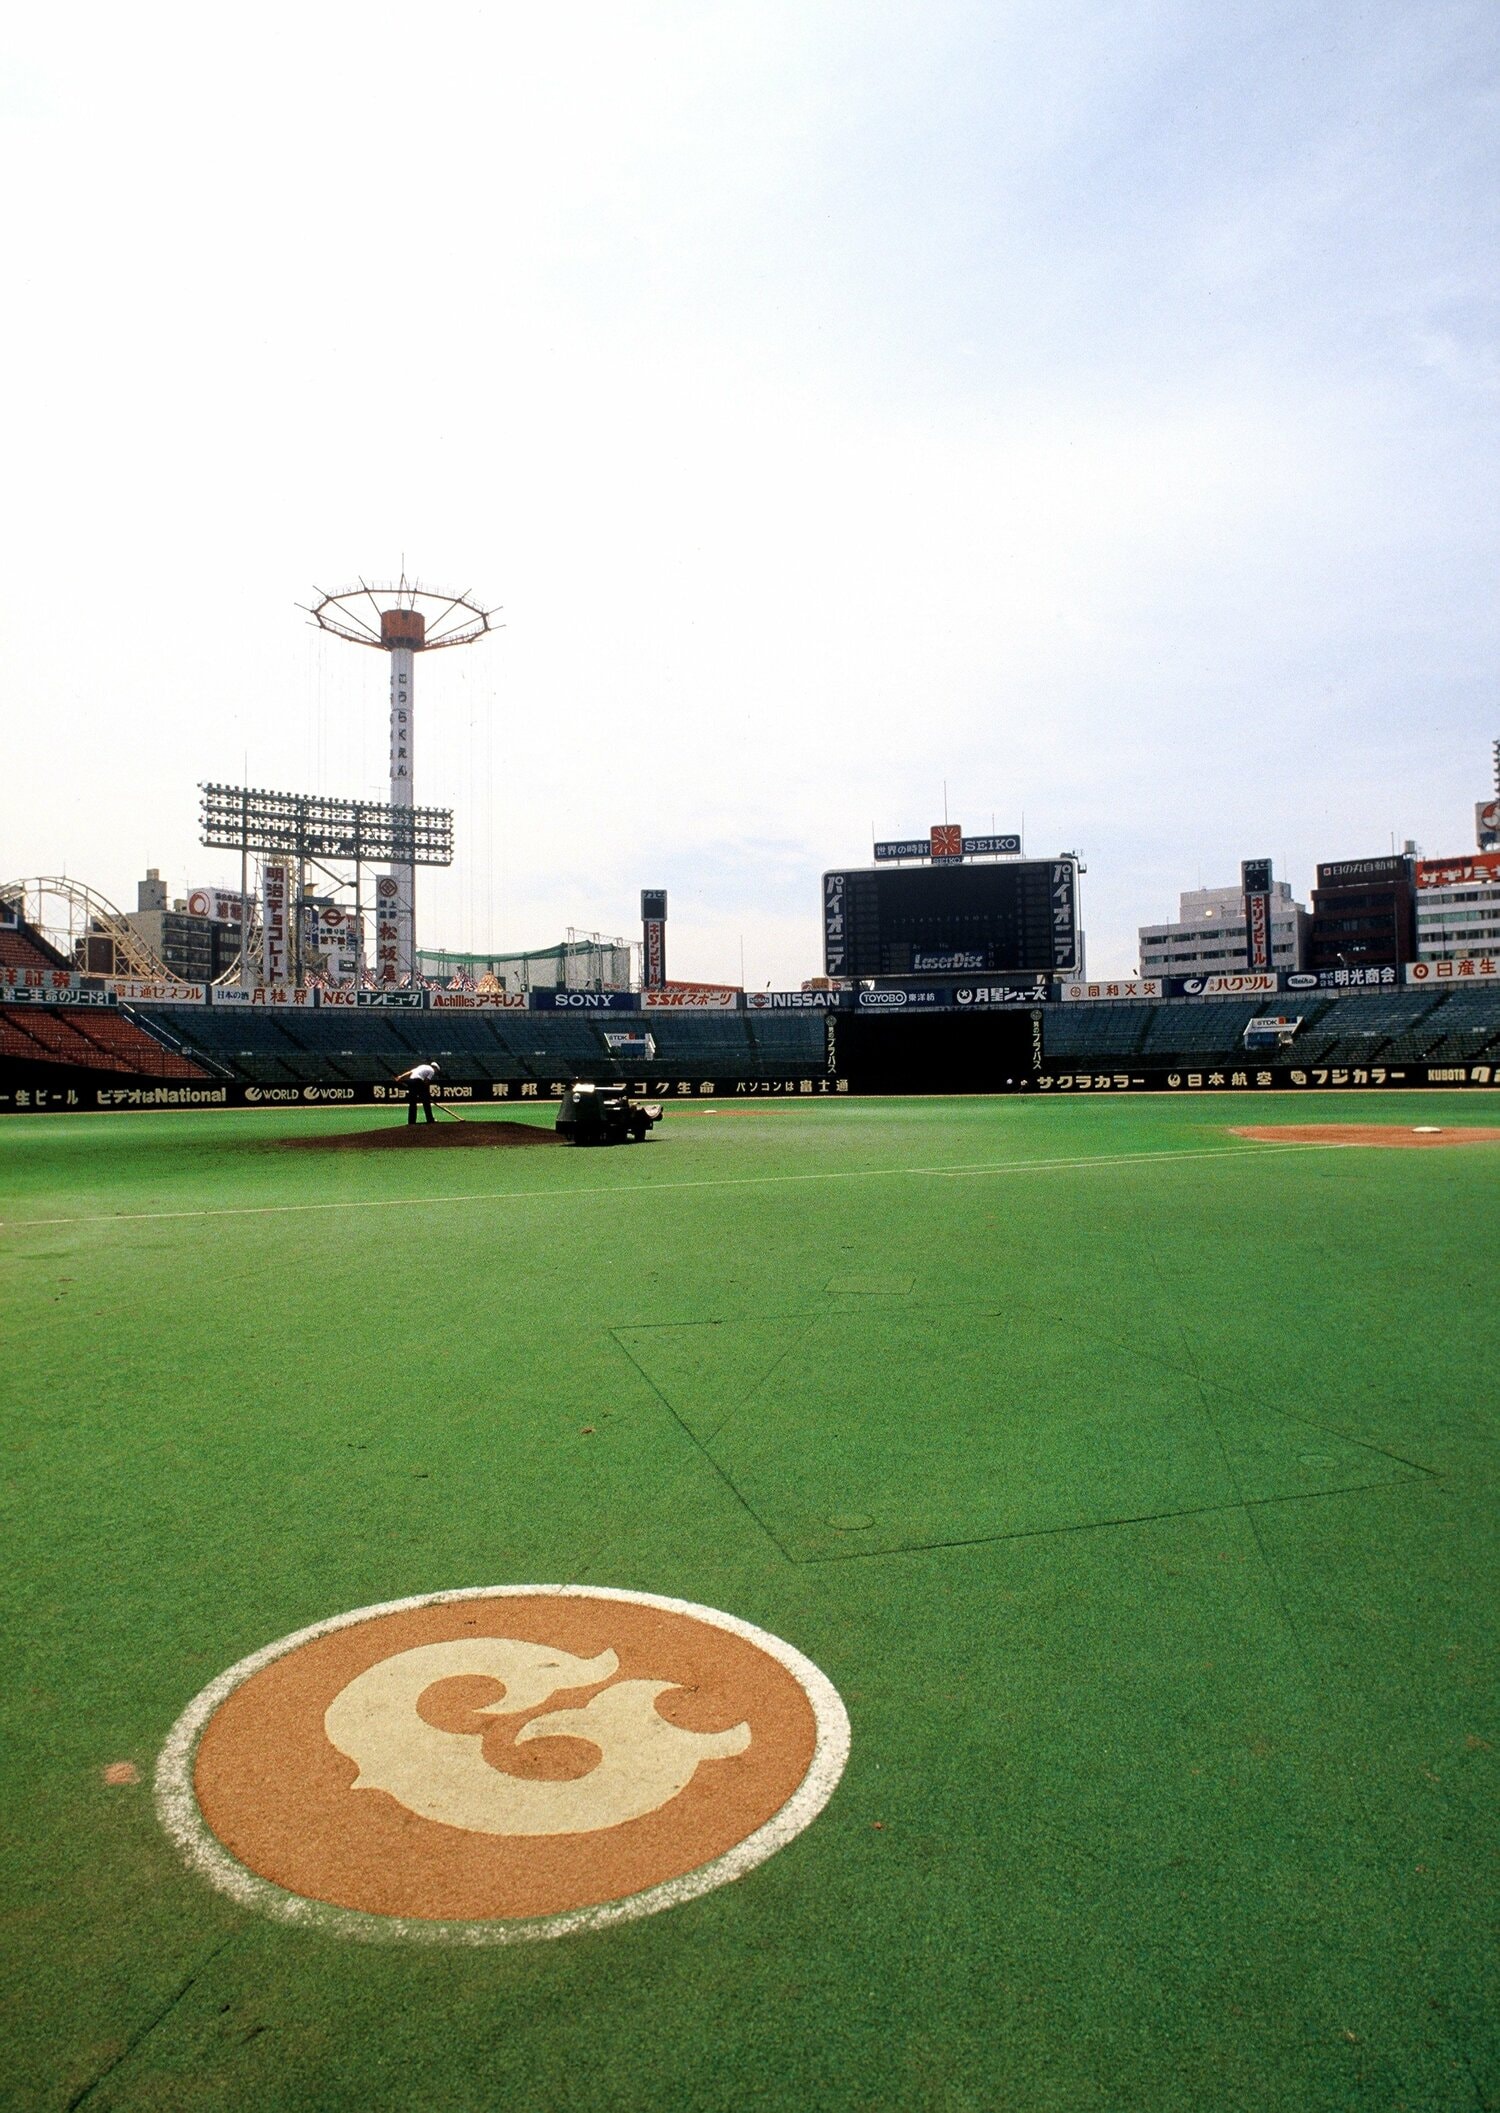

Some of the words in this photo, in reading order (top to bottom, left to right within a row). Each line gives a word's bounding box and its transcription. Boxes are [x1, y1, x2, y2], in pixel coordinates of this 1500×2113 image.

[876, 844, 929, 857] 世界の時計
[964, 838, 1017, 852] SEIKO
[933, 857, 961, 865] SEIKO
[1333, 861, 1397, 876] 日の丸自動車
[1052, 863, 1073, 966] パイオニア
[267, 867, 283, 983] 明治チョコレート
[826, 876, 845, 974] パイオニア
[1252, 897, 1265, 965] キリンビール
[380, 922, 397, 982] 松坂屋
[650, 924, 660, 984] キリンビール
[914, 952, 983, 970] LaserDisc
[1437, 957, 1496, 977] 日産生
[1334, 966, 1396, 985] 明光商会
[114, 982, 204, 1001] 富士通ゼネラル
[1088, 984, 1157, 998] 同和火災
[1215, 976, 1273, 992] ハクツル
[3, 987, 109, 1005] 第一生命のリード21
[217, 990, 250, 1001] 日本の酒
[252, 988, 307, 1005] 月桂冠
[322, 992, 355, 1006] NEC
[358, 992, 420, 1006] コンピュータ
[554, 993, 615, 1006] SONY
[773, 992, 840, 1007] NISSAN
[863, 994, 904, 1003] TOYOBO
[907, 992, 935, 1003] 東洋紡
[975, 987, 1048, 1003] 月星シューズ
[1036, 1074, 1145, 1089] サクラカラー
[1187, 1070, 1273, 1086] 日本航空
[1311, 1067, 1406, 1084] フジカラー
[1427, 1068, 1466, 1081] KUBOTA
[1470, 1066, 1500, 1083] ク
[262, 1088, 299, 1101] WORLD
[318, 1087, 355, 1099] WORLD
[443, 1086, 473, 1097] RYOBI
[492, 1083, 567, 1096] 東邦生
